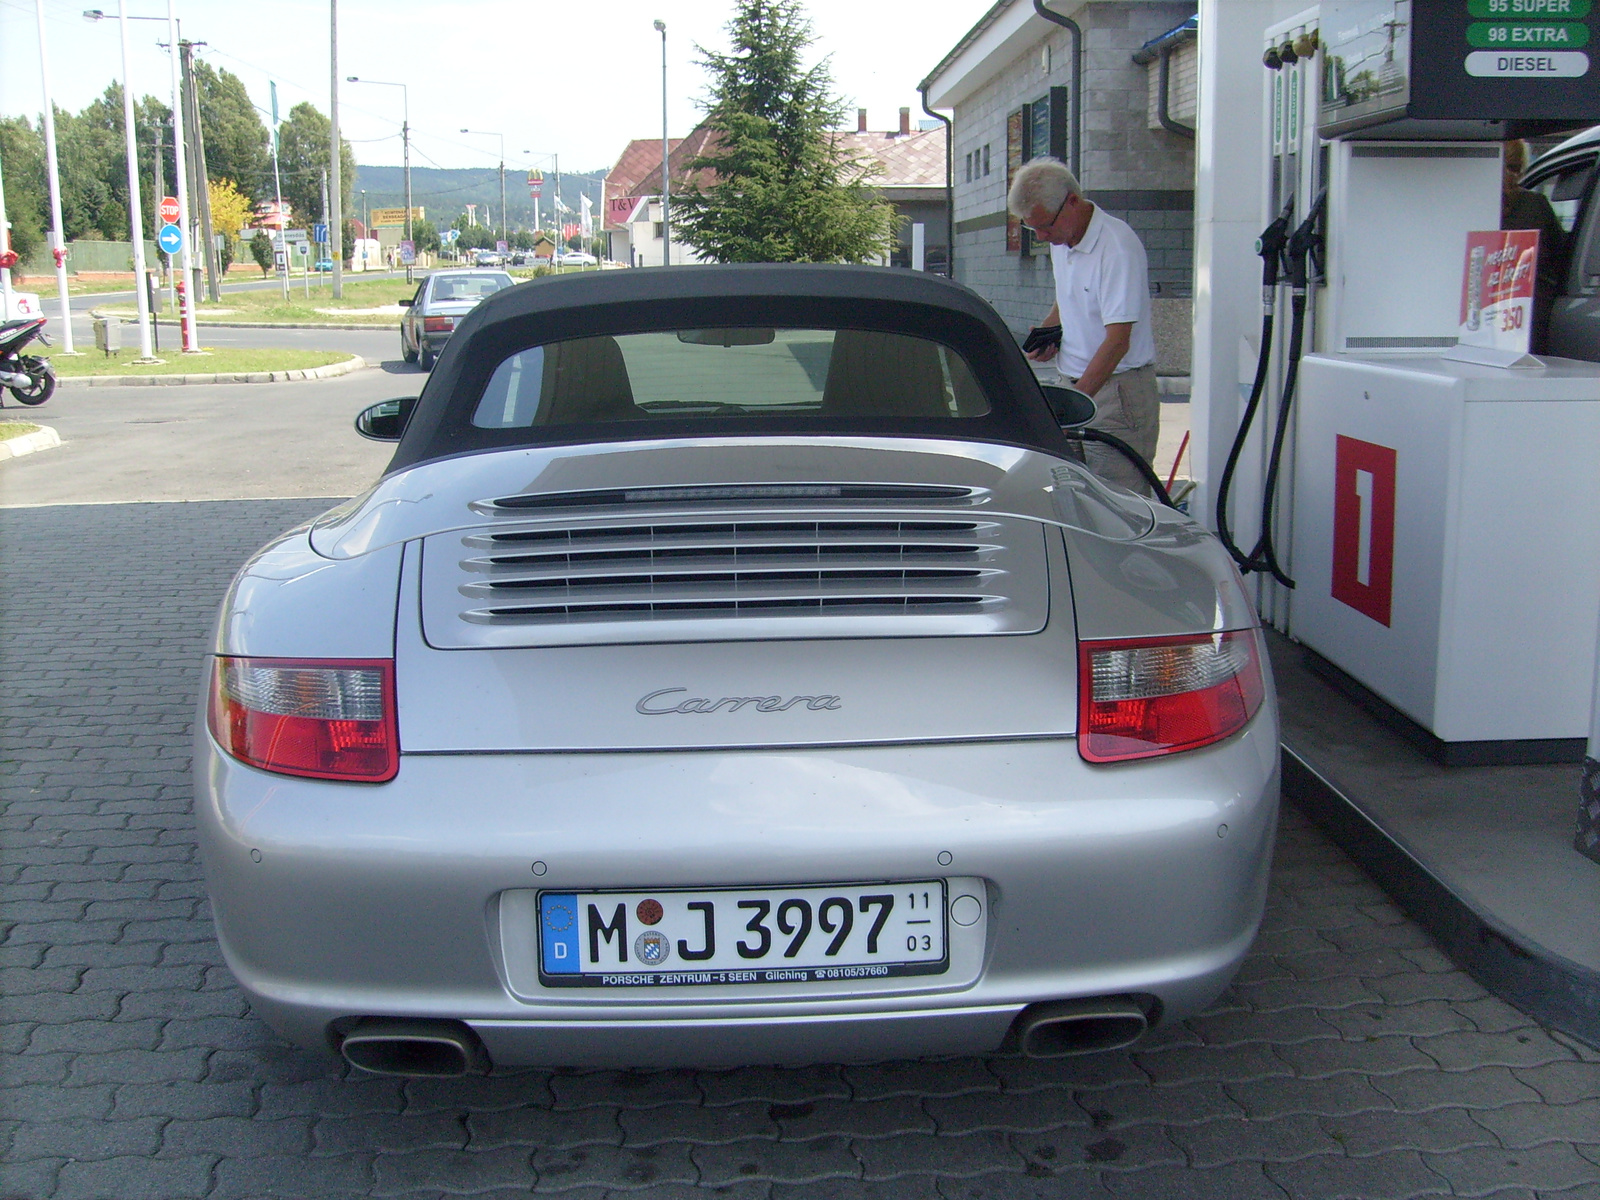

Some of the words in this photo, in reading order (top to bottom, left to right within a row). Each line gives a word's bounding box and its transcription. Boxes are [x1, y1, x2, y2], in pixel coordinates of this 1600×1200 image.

[1489, 0, 1508, 12] 95
[1512, 0, 1570, 12] SUPER
[1488, 28, 1507, 42] 98
[1511, 28, 1568, 42] EXTRA
[1497, 57, 1557, 71] DIESEL
[161, 205, 179, 216] STOP
[1356, 468, 1373, 586] 1
[635, 687, 842, 715] Carrera
[908, 892, 930, 909] 11
[588, 903, 628, 963] M
[677, 901, 715, 961] J
[736, 894, 895, 959] 3997
[554, 942, 568, 959] D
[907, 935, 931, 952] 03
[602, 974, 654, 985] PORSCHE
[728, 972, 757, 981] SEEN
[765, 970, 808, 981] Gilching
[827, 966, 888, 978] 08105/37660
